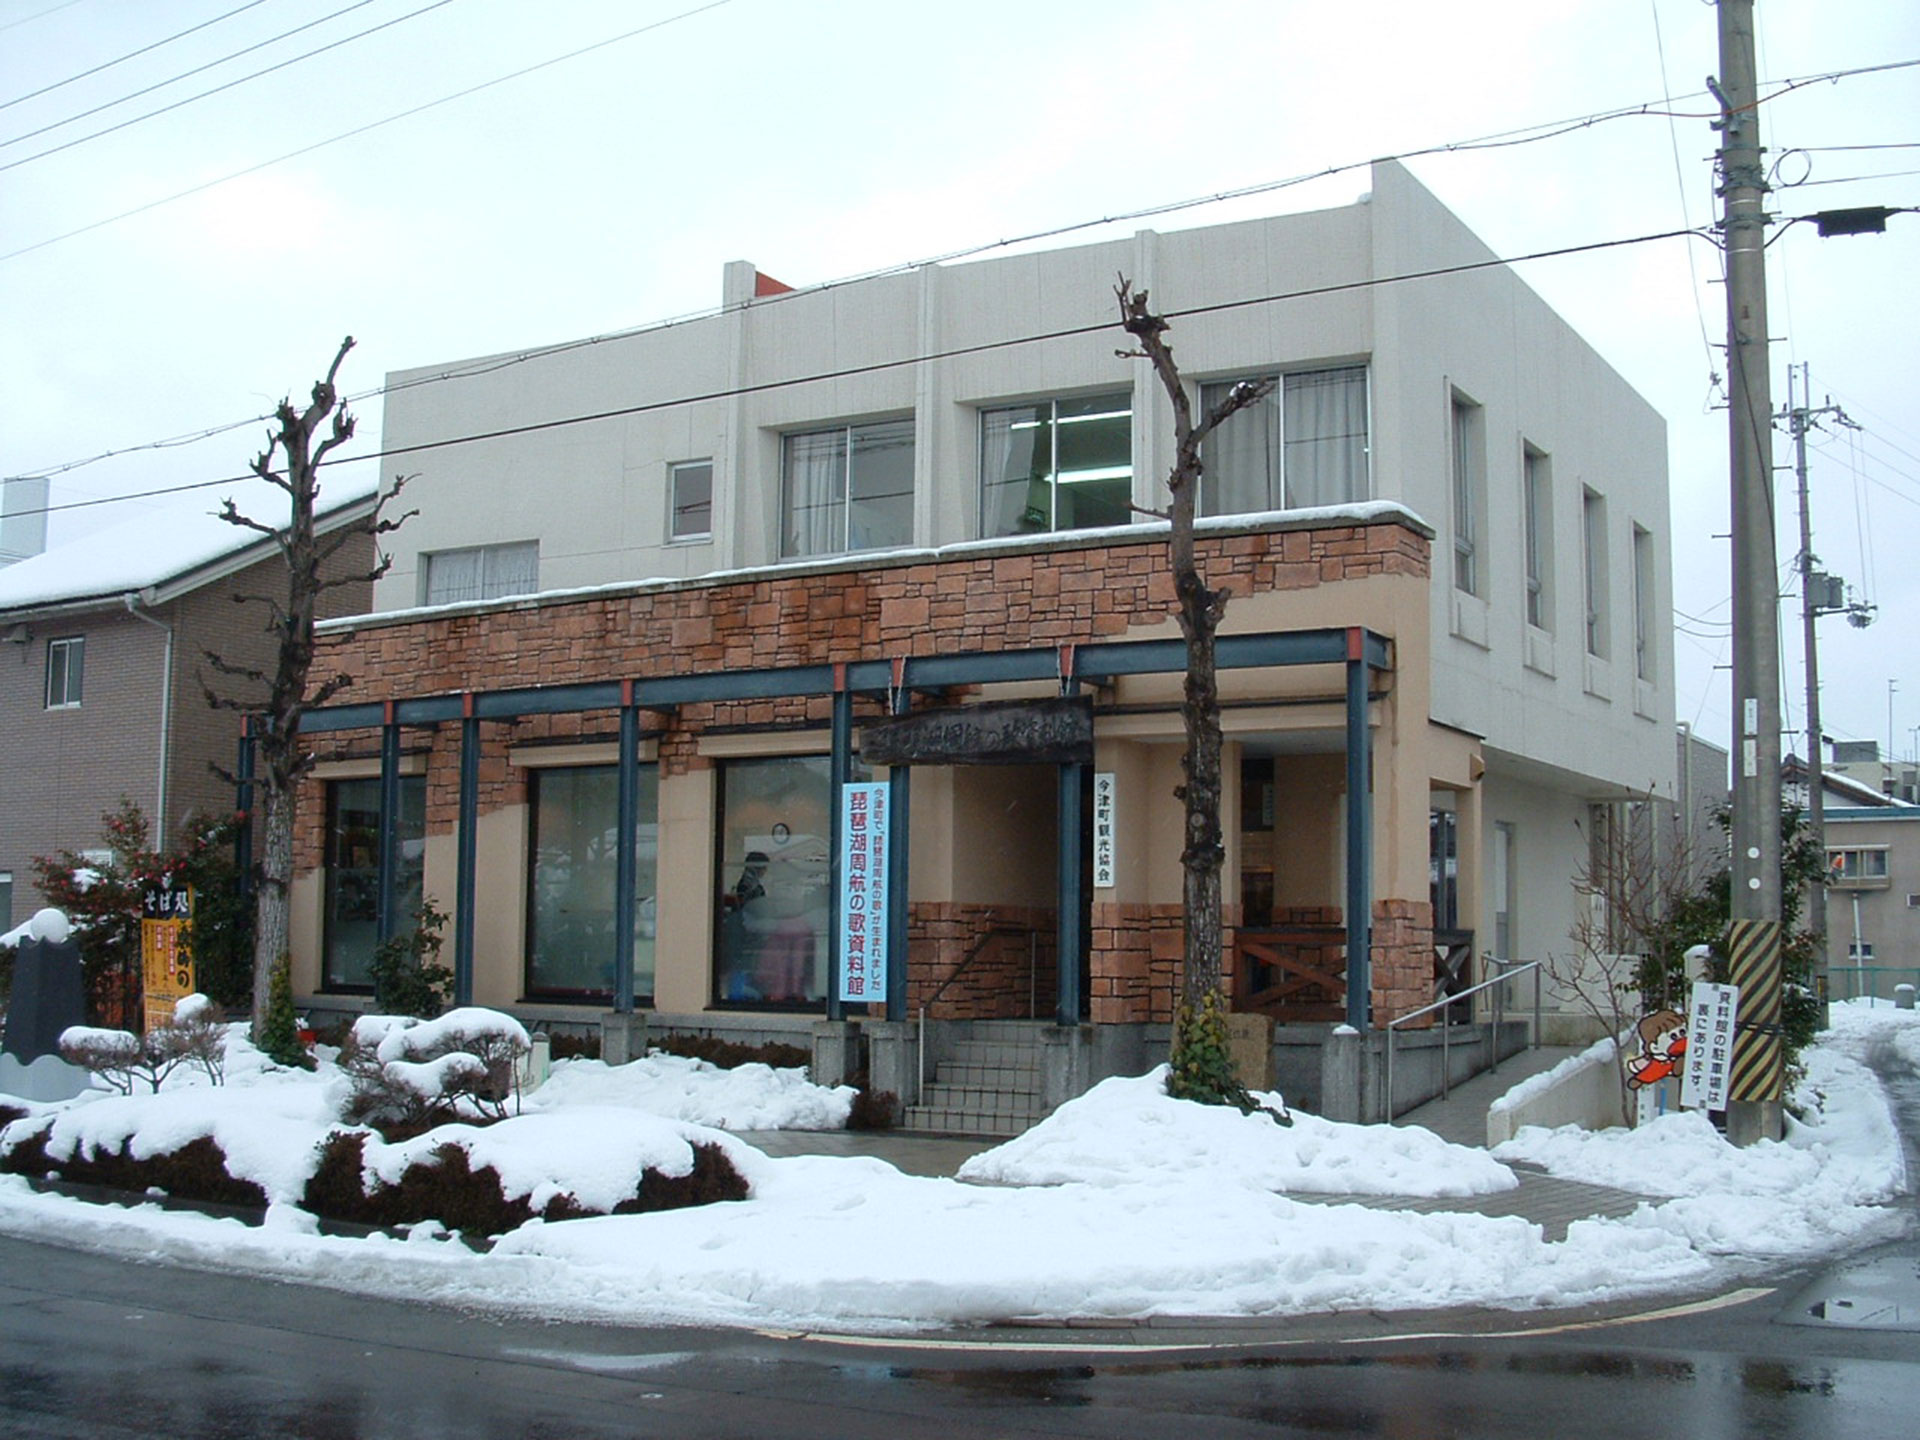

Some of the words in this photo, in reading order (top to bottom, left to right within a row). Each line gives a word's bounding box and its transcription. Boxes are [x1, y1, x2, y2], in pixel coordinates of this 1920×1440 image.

[1098, 779, 1110, 881] 今津町観光協会
[144, 890, 189, 913] そば処
[847, 791, 867, 995] 琵琶湖周航の歌資料館
[1708, 991, 1731, 1103] 資料館の駐車場は
